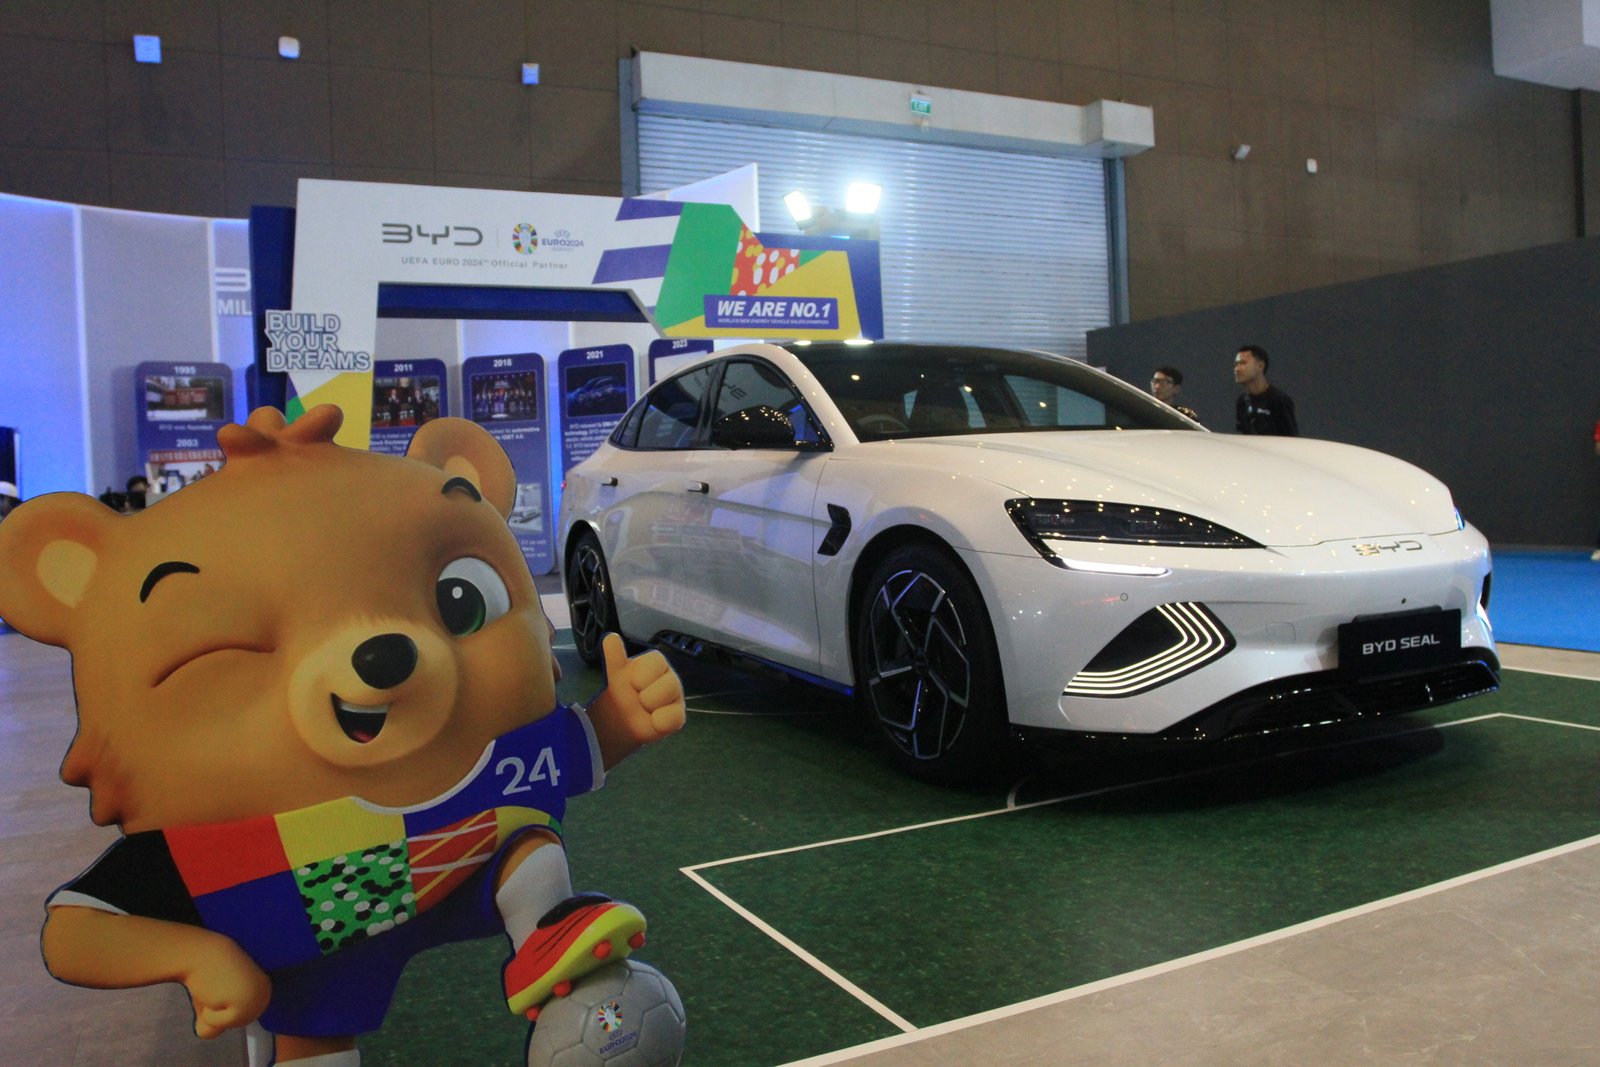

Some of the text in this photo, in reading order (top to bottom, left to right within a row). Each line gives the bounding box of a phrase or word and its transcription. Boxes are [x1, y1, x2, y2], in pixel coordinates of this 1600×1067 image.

[382, 223, 483, 246] BYD
[541, 239, 584, 247] EURO2024
[401, 257, 429, 265] UEFA
[432, 258, 459, 266] EURO
[491, 260, 528, 268] Official
[532, 261, 568, 270] Partner
[717, 300, 831, 318] WE ARE NO.1
[268, 312, 341, 332] BUILD
[269, 331, 340, 351] YOUR
[269, 350, 370, 371] DREAMS
[493, 359, 512, 367] 2018
[586, 351, 604, 360] 2021
[174, 366, 196, 375] 1995
[394, 364, 413, 372] 2011
[1352, 540, 1422, 556] BYD
[1362, 634, 1440, 655] BYD SEAL
[495, 746, 561, 796] 24
[599, 1030, 638, 1054] EURO2024
